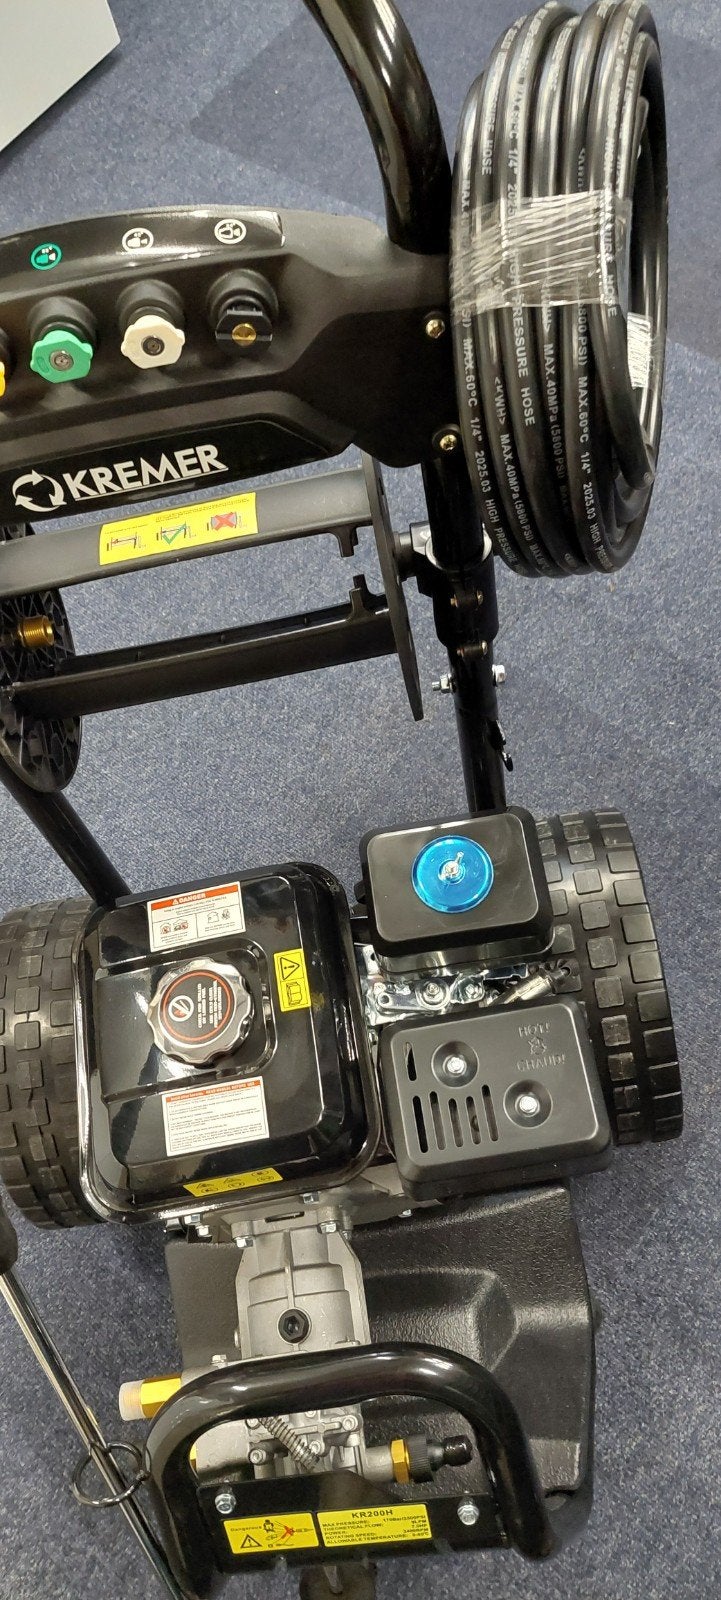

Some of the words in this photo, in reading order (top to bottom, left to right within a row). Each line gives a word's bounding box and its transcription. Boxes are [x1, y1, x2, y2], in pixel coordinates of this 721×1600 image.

[481, 139, 494, 176] HOSE
[605, 274, 618, 317] HOSE
[511, 294, 530, 378] PRESSURE
[521, 386, 536, 426] HOSE
[578, 336, 588, 366] PSI)
[543, 343, 560, 423] MAX.40MPa
[470, 417, 483, 442] 1/4"
[62, 443, 229, 500] KREMER
[474, 450, 492, 493] 2025.03
[500, 433, 521, 500] MAX.40MPa
[580, 451, 591, 474] 1/4"
[485, 499, 500, 523] HIGH
[583, 482, 597, 520] 2025.03
[589, 523, 602, 544] HIGH
[179, 893, 206, 904] DANGER
[351, 1509, 393, 1518] KR200H
